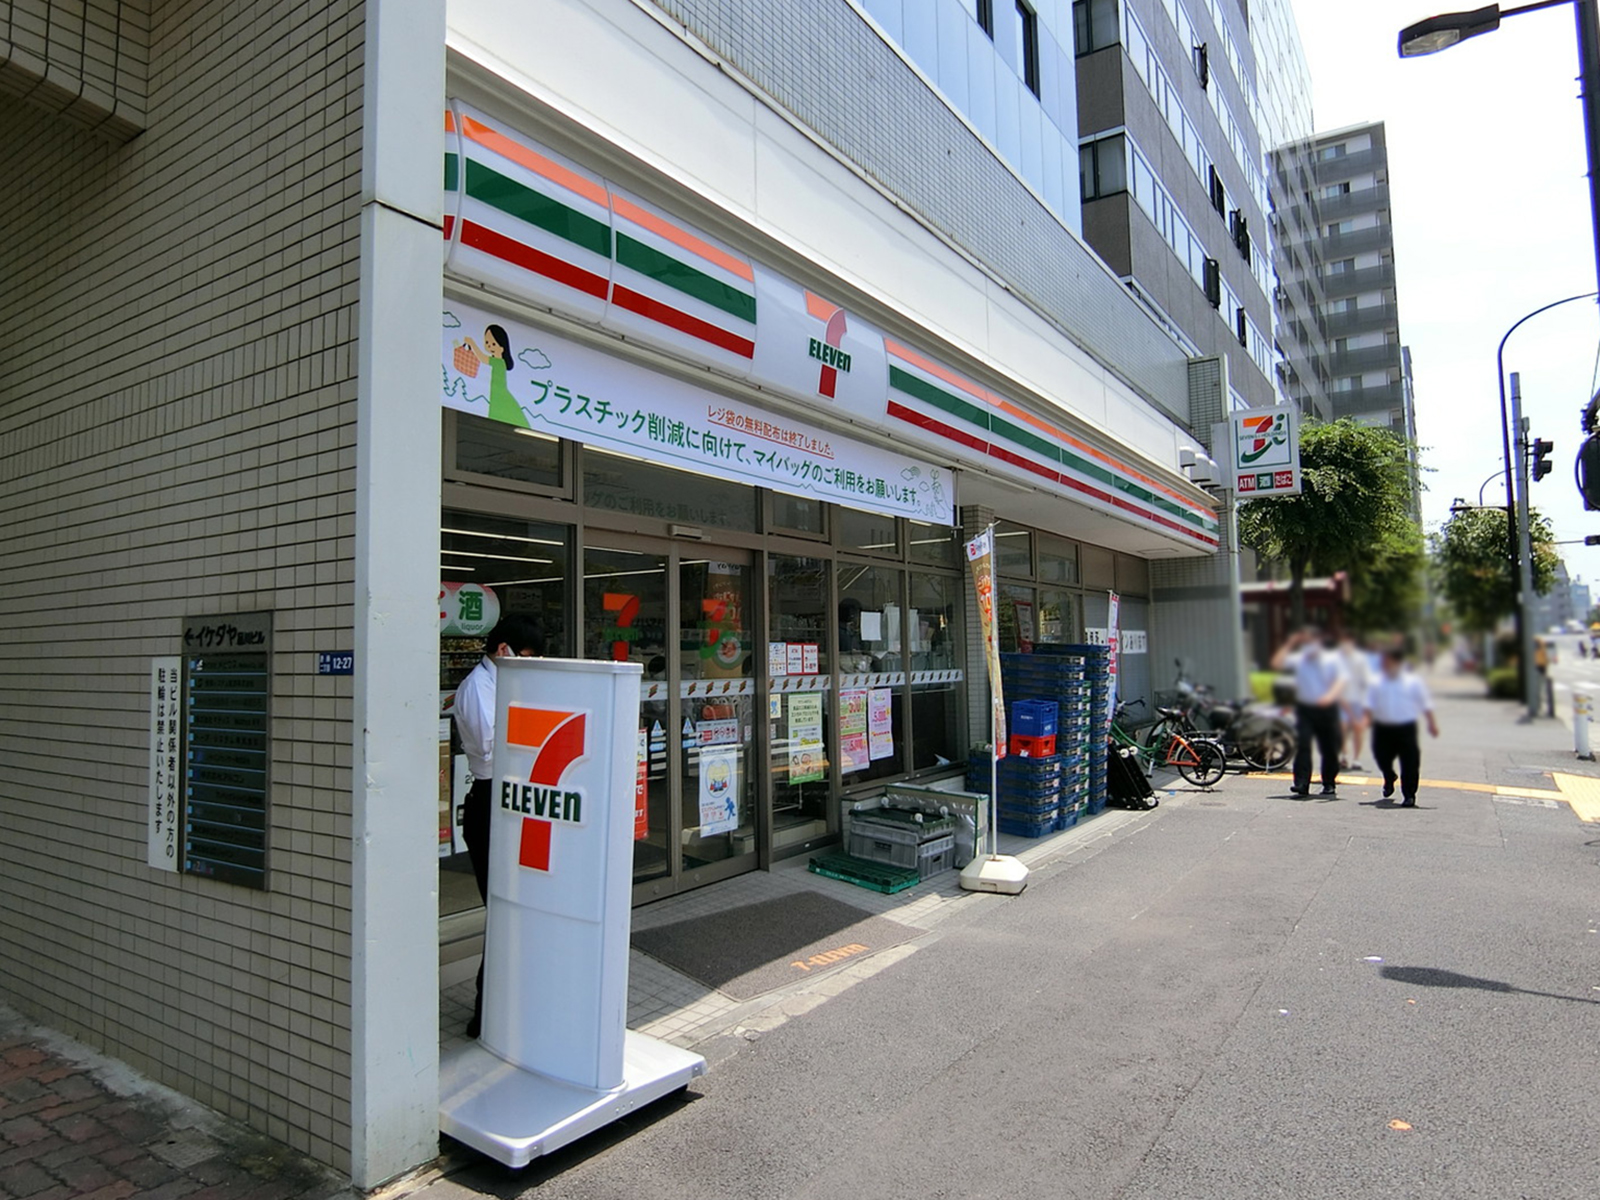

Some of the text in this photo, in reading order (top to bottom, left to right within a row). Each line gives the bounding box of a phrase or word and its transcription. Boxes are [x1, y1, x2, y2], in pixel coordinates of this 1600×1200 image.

[804, 288, 848, 399] 7
[530, 379, 921, 506] プラスチック削減に向けて、マイバッグのご利用をお願いします。
[708, 405, 835, 457] レジ袋の無料配布は終了しました。
[1238, 477, 1255, 489] ATM
[1259, 475, 1271, 488] 酒
[1275, 473, 1292, 486] たばこ
[458, 590, 483, 621] 酒
[461, 622, 483, 632] liquor
[332, 656, 353, 670] 12-27
[155, 667, 166, 833] 駐輪は禁止いたします
[165, 667, 178, 858] 当ビル関係者以外の方の
[501, 780, 582, 823] ELEVEn
[506, 705, 587, 872] 7
